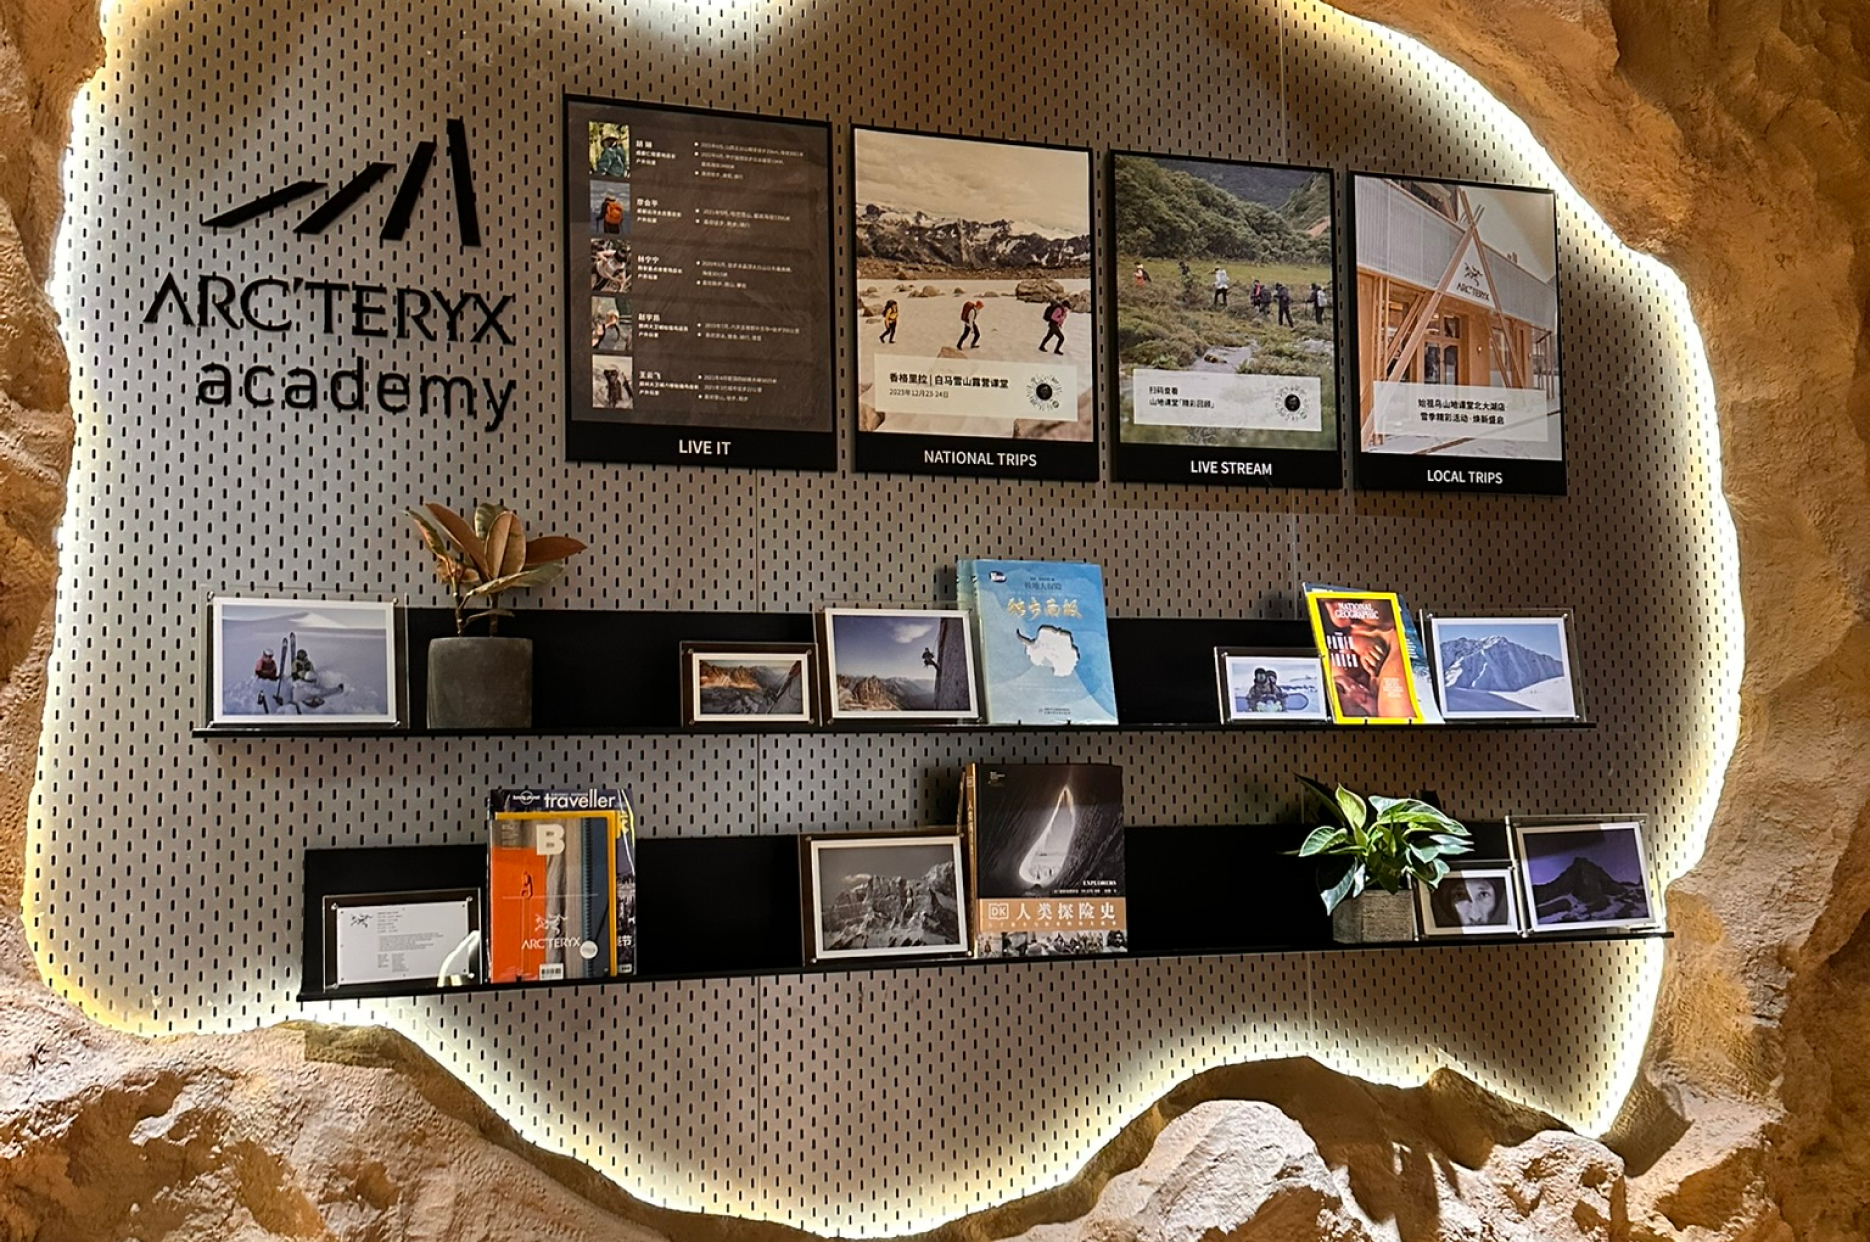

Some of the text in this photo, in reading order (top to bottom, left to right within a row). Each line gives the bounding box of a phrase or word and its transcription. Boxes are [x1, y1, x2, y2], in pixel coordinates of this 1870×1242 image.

[143, 271, 516, 346] ARC'TERYX
[197, 355, 518, 433] academy
[678, 438, 732, 456] LIVE IT
[924, 450, 1038, 468] NATIONAL TRIPS
[1190, 459, 1273, 476] LIVE STREAM
[1427, 469, 1504, 485] LOCAL TRIPS
[1334, 609, 1380, 620] GEOGRAPHIC
[1337, 602, 1372, 611] NATIONAL
[543, 788, 617, 809] traveller
[536, 823, 566, 856] B
[991, 901, 1116, 920] DK 人类探险史
